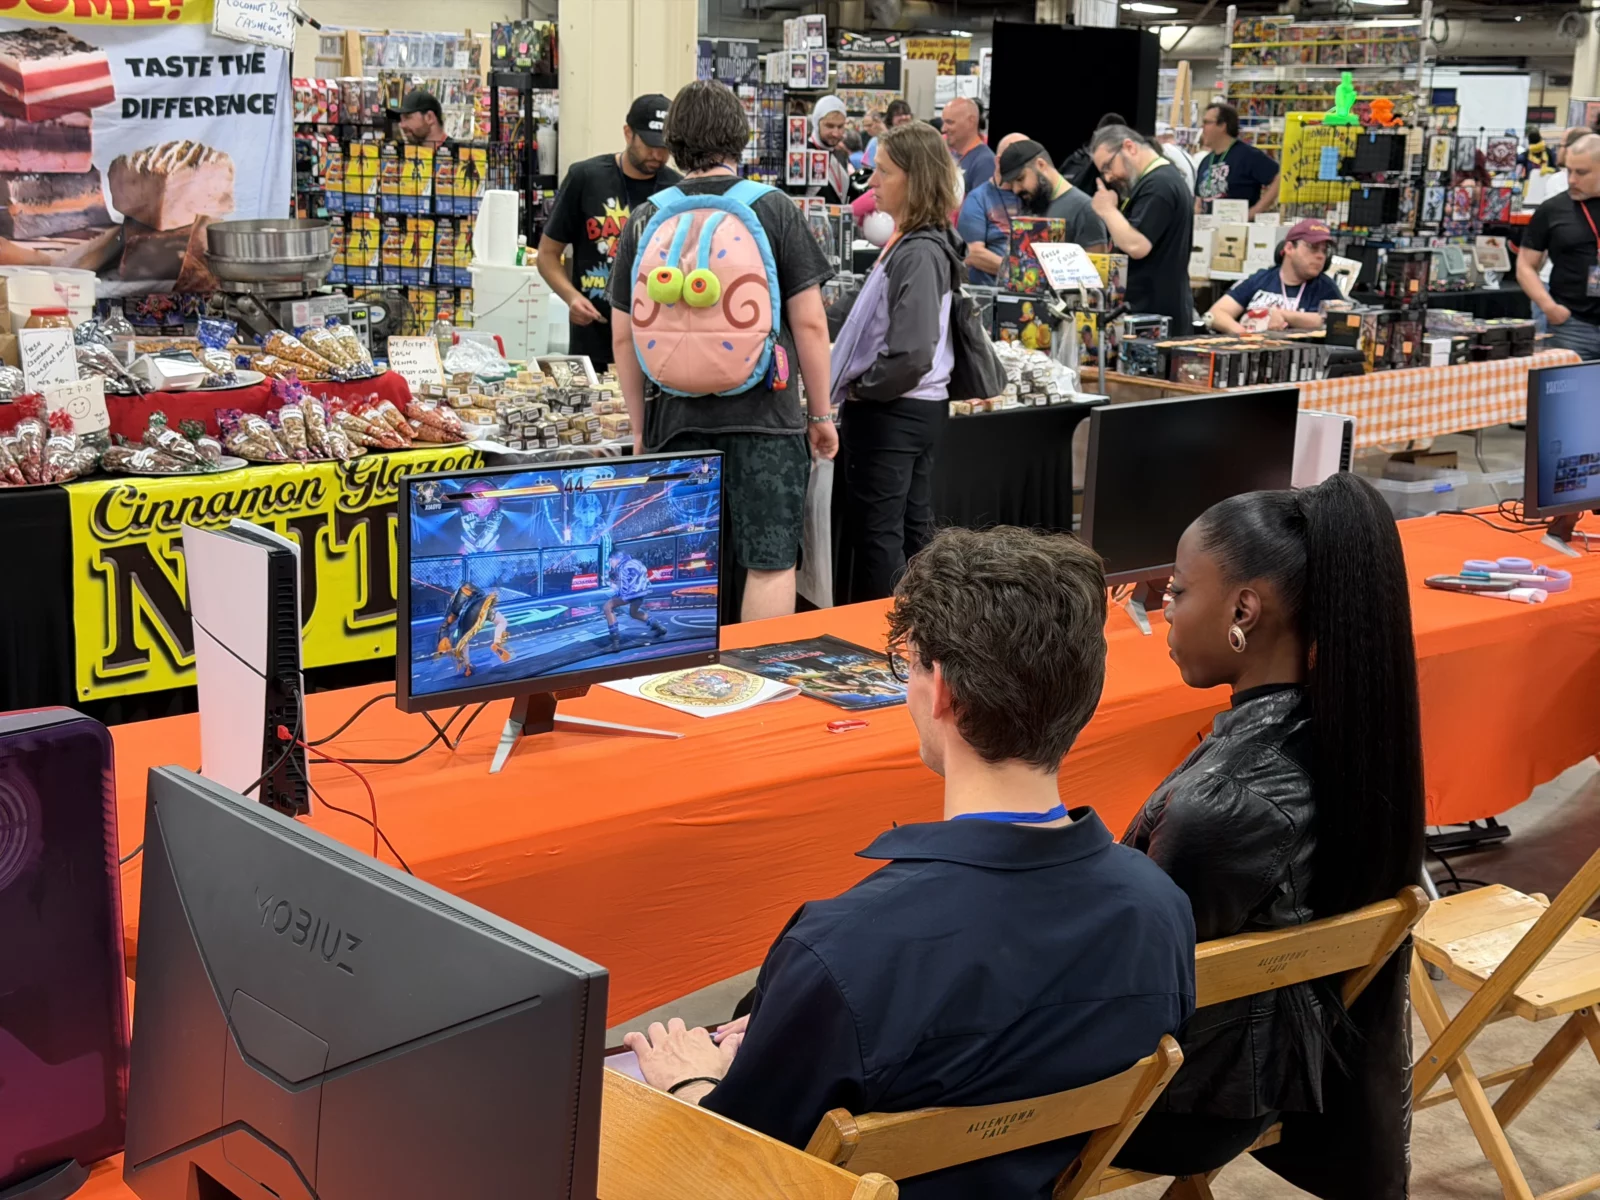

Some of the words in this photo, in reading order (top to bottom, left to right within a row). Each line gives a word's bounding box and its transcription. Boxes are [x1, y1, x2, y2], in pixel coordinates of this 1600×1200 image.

[125, 56, 214, 77] TASTE
[218, 52, 266, 75] THE
[121, 93, 277, 119] DIFFERENCE
[55, 384, 91, 398] TIPS
[565, 476, 584, 493] 44
[92, 477, 325, 540] Cinnamon
[966, 1109, 1035, 1134] ALLENTOWN
[981, 1125, 1010, 1140] FAIR
